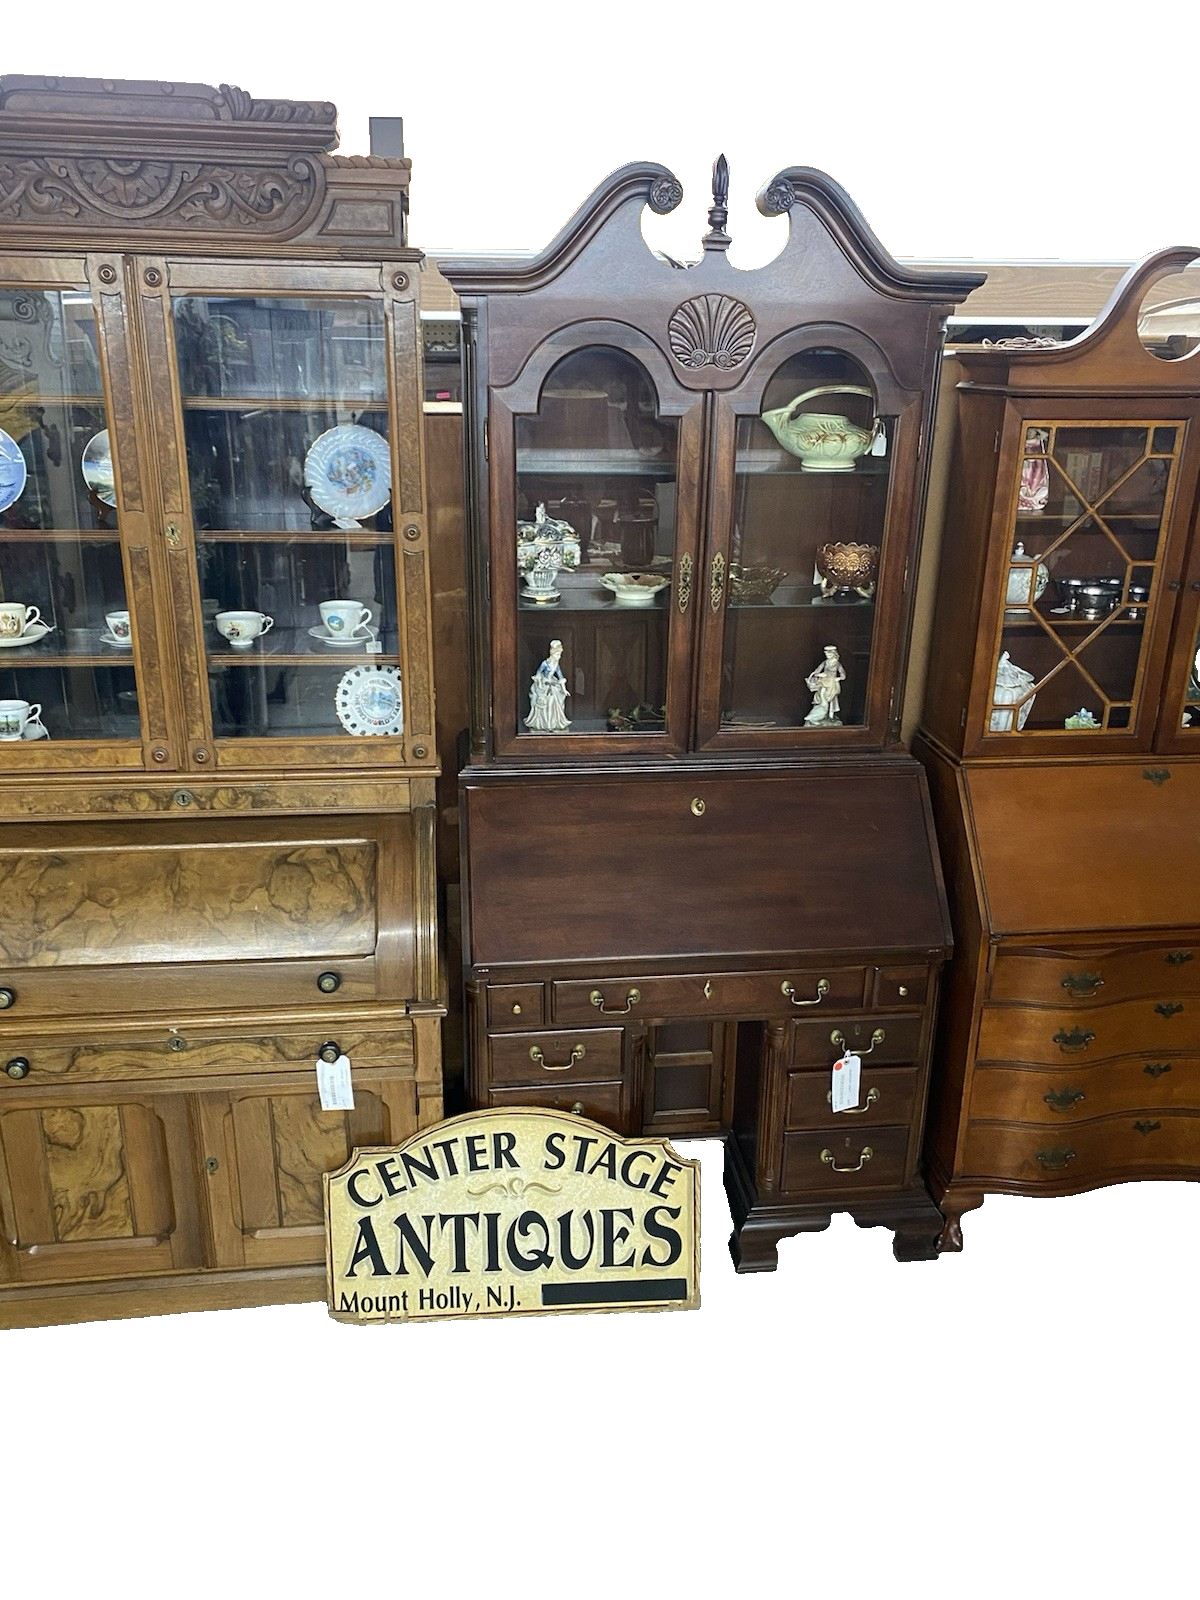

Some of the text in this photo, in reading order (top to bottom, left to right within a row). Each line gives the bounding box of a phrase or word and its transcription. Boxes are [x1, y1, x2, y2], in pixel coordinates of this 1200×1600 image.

[347, 1132, 683, 1208] CENTER STAGE
[345, 1205, 683, 1279] ANTIQUES
[339, 1285, 522, 1313] Mount Holly, N.J.
